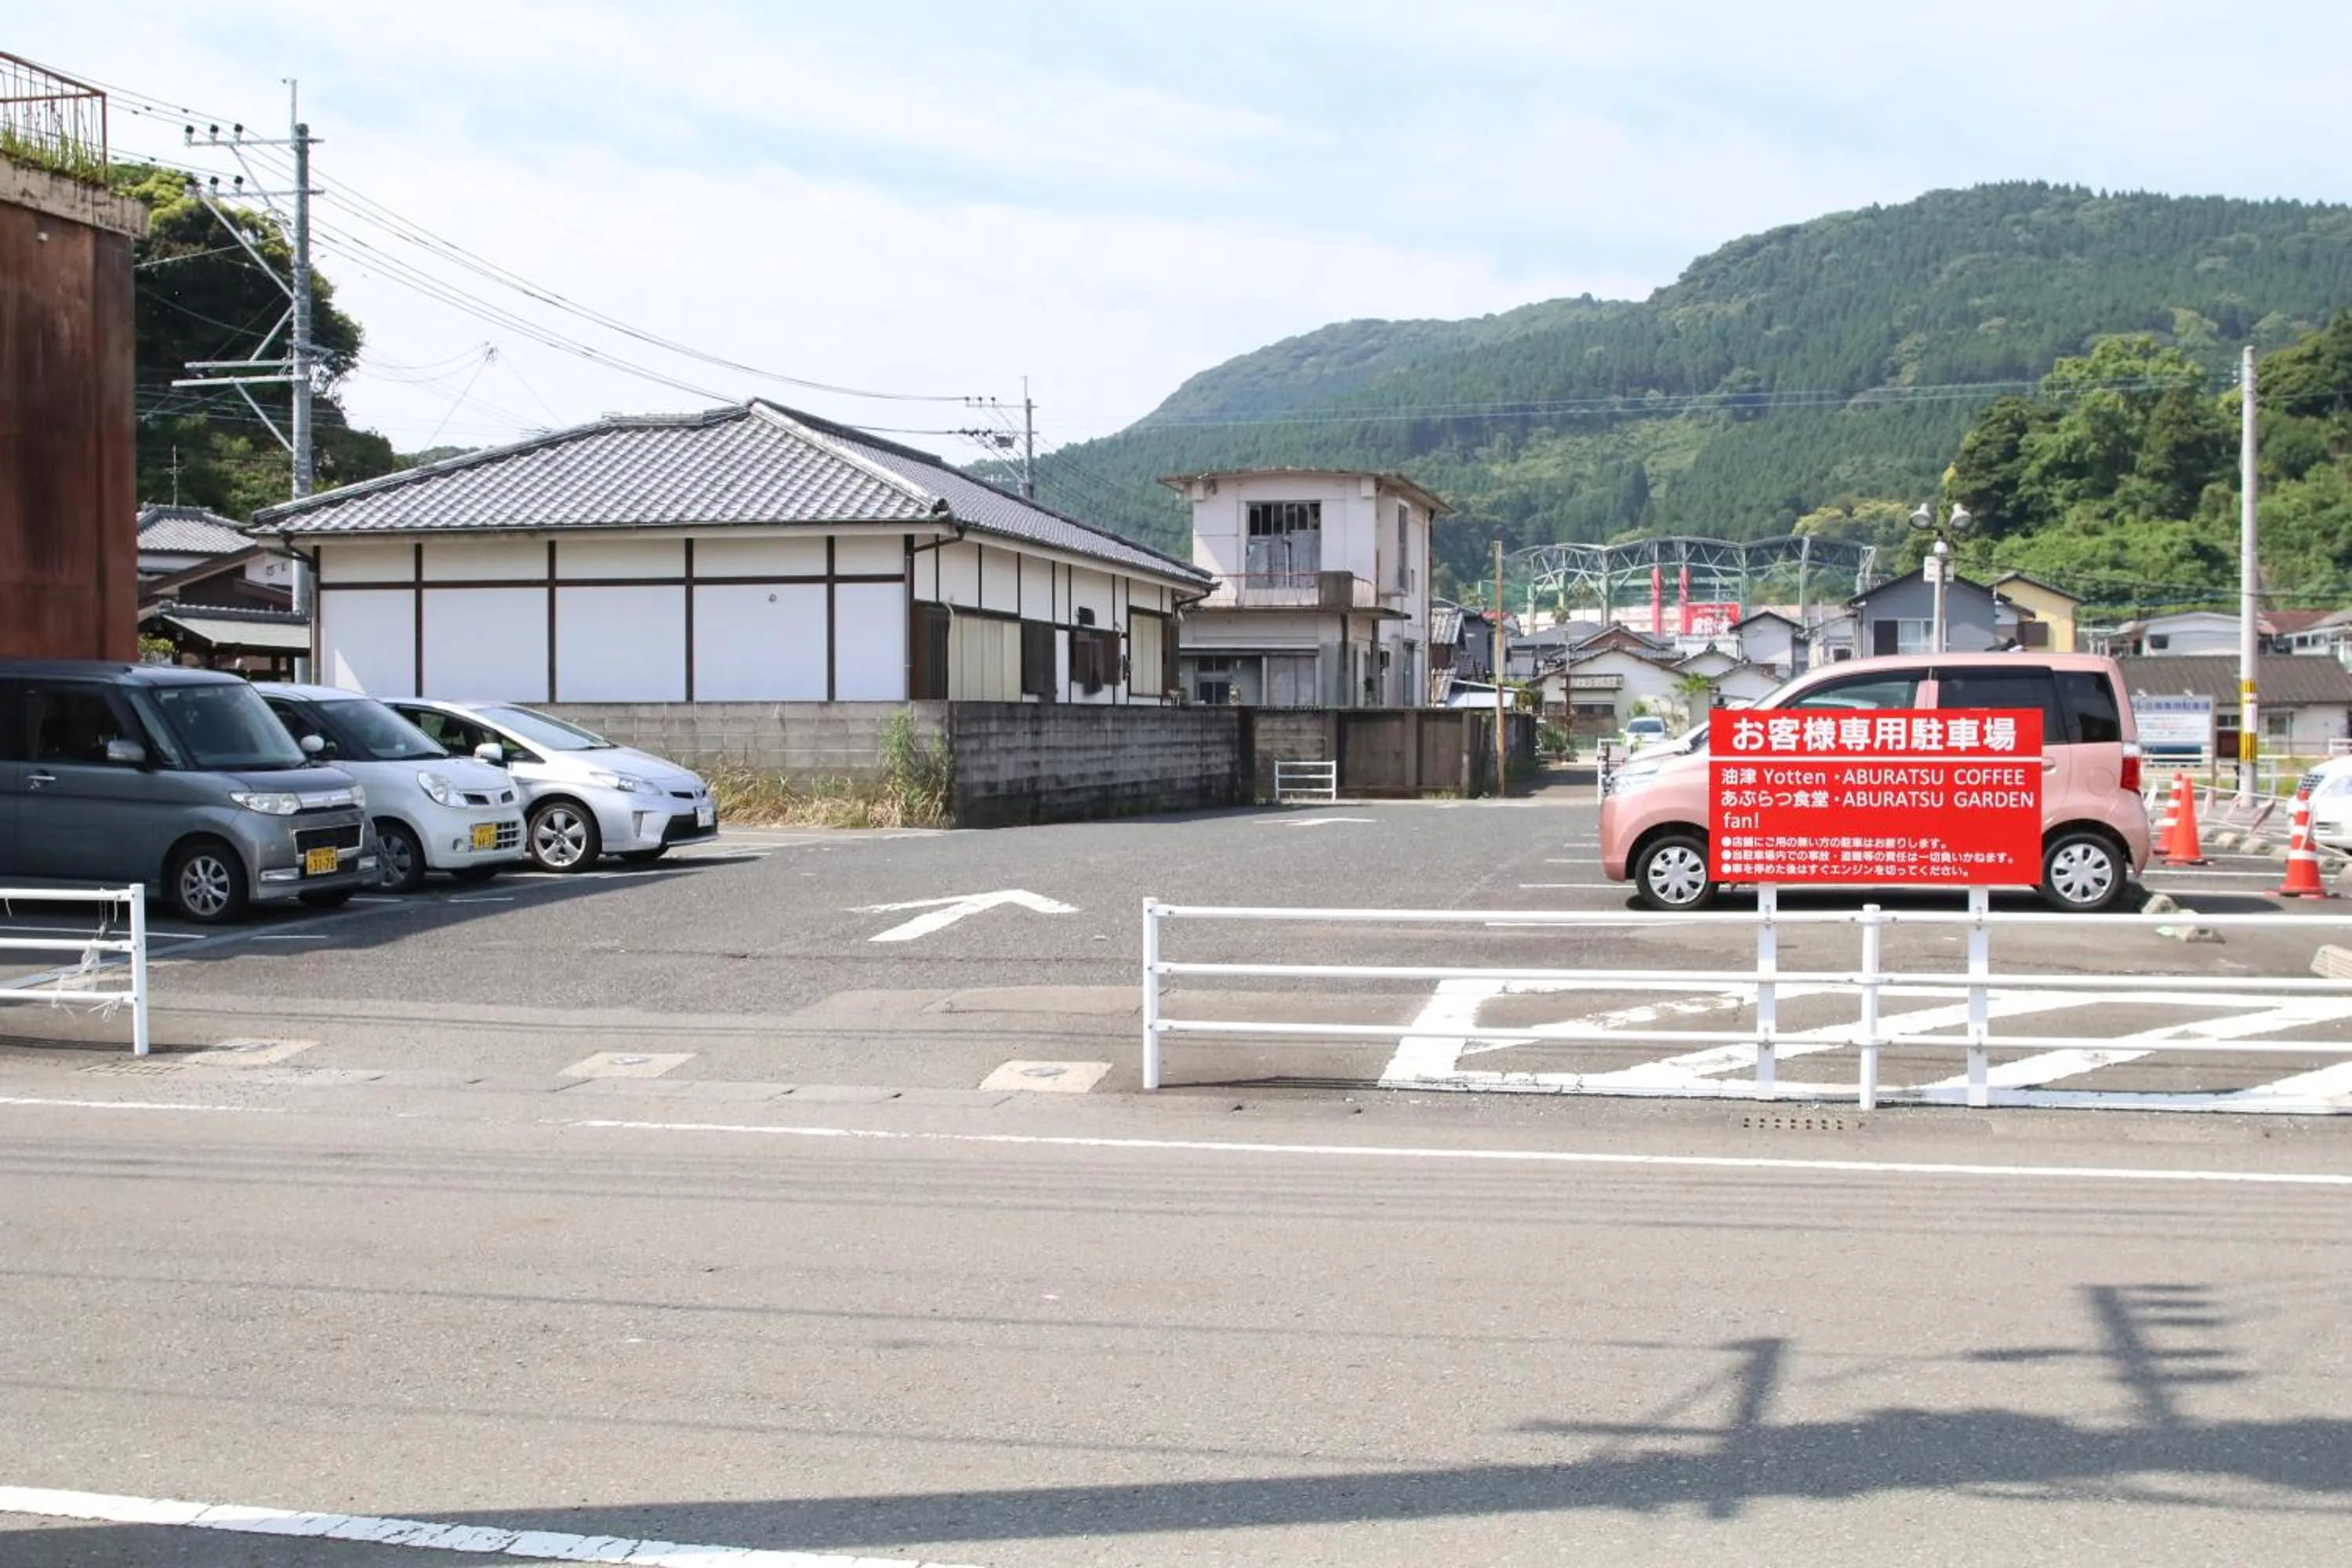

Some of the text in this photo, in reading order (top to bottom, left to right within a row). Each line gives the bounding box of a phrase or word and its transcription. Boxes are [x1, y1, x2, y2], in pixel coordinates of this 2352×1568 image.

[1733, 716, 2016, 752] お客様専用駐車場
[1722, 768, 1756, 786] 油津
[1955, 769, 2025, 786] COFFEE
[1954, 792, 2034, 808] GARDEN
[1723, 811, 1759, 829] fan!
